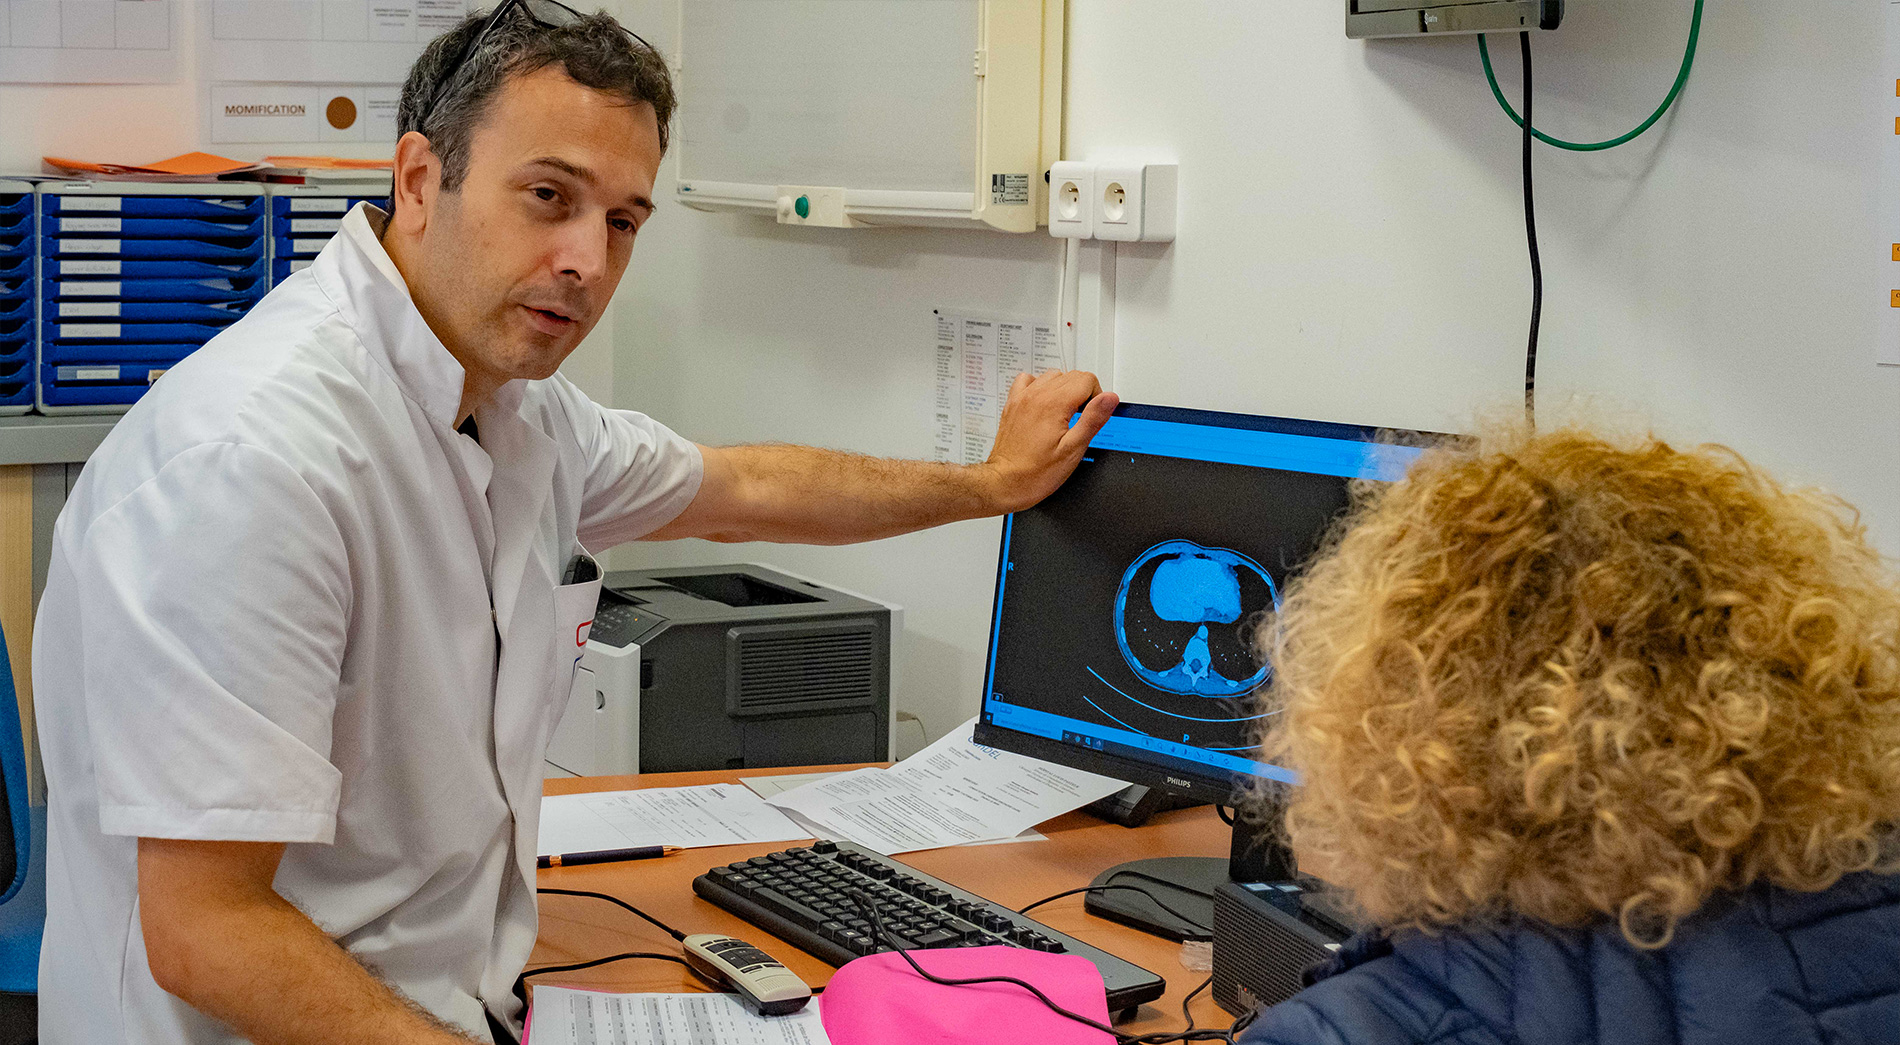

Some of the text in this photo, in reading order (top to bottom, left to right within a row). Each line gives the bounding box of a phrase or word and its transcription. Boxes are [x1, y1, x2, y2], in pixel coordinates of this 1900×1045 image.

[225, 105, 306, 116] MOMIFICATION
[1008, 562, 1014, 571] R
[1183, 734, 1190, 743] P
[1167, 776, 1191, 788] PHILIPS
